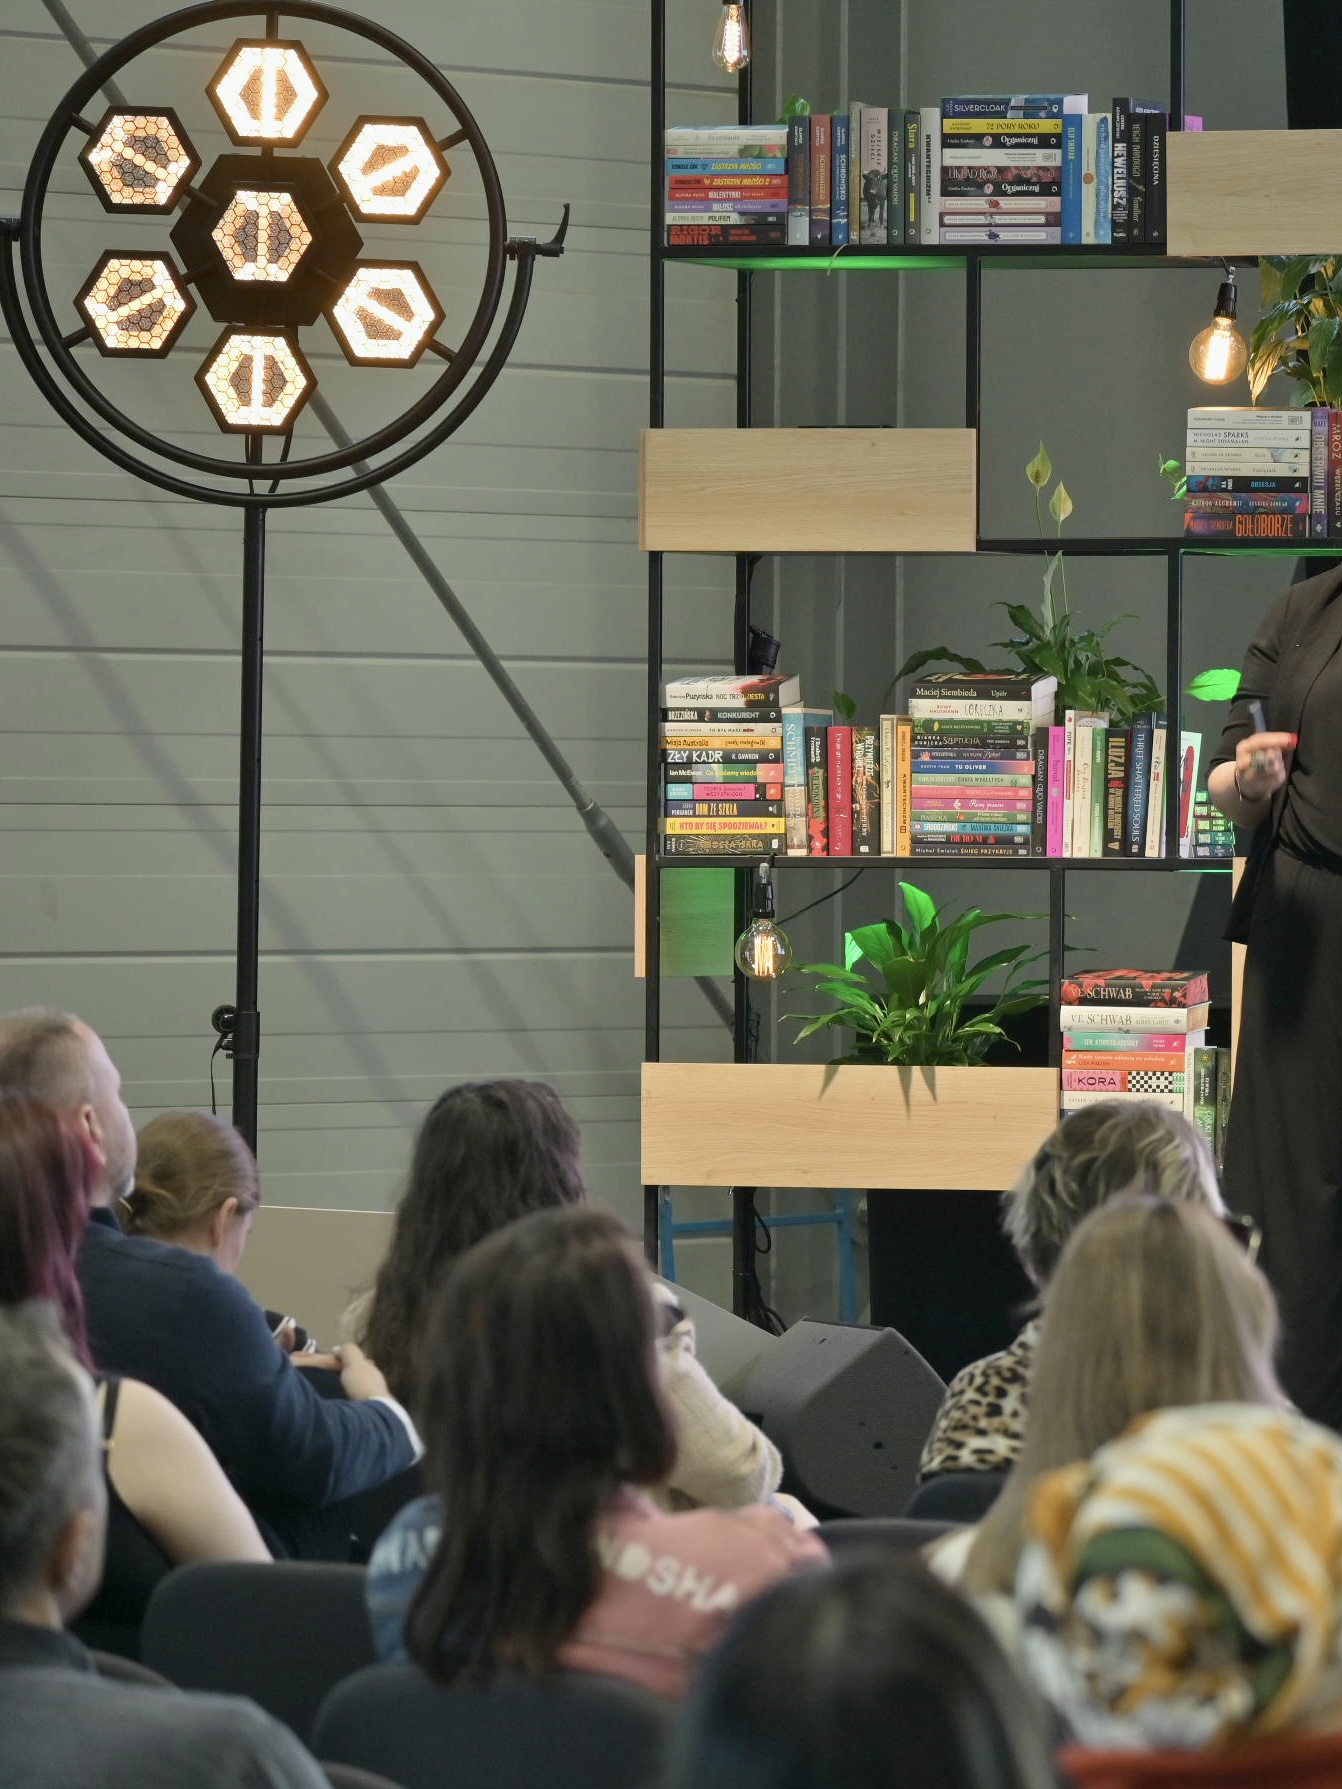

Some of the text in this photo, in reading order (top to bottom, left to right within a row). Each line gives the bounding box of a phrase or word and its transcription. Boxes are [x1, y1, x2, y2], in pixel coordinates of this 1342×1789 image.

[907, 123, 918, 149] Siara
[1151, 135, 1160, 185] DZIESIĘCINA
[1113, 143, 1127, 205] HEWELIUSZ
[1331, 423, 1342, 460] MRÓZ
[1235, 514, 1293, 537] GOŁOBORZE
[685, 692, 713, 701] Puzyńska
[915, 687, 940, 698] Maciej
[941, 688, 977, 697] Siembieda
[717, 711, 760, 719] KONKURENT
[667, 750, 723, 762] ZŁY KADR
[1134, 732, 1145, 761] THREE
[1037, 749, 1045, 781] DRAGAN
[1107, 737, 1126, 778] ILUZJA
[1035, 783, 1045, 800] QUO
[679, 821, 767, 832] KTO BY SIĘ SPODZIEWAŁ?
[1131, 811, 1141, 842] SOULS
[1086, 987, 1133, 999] SCHWAB
[1086, 1013, 1132, 1025] SCHWAB
[1077, 1076, 1117, 1086] KORA
